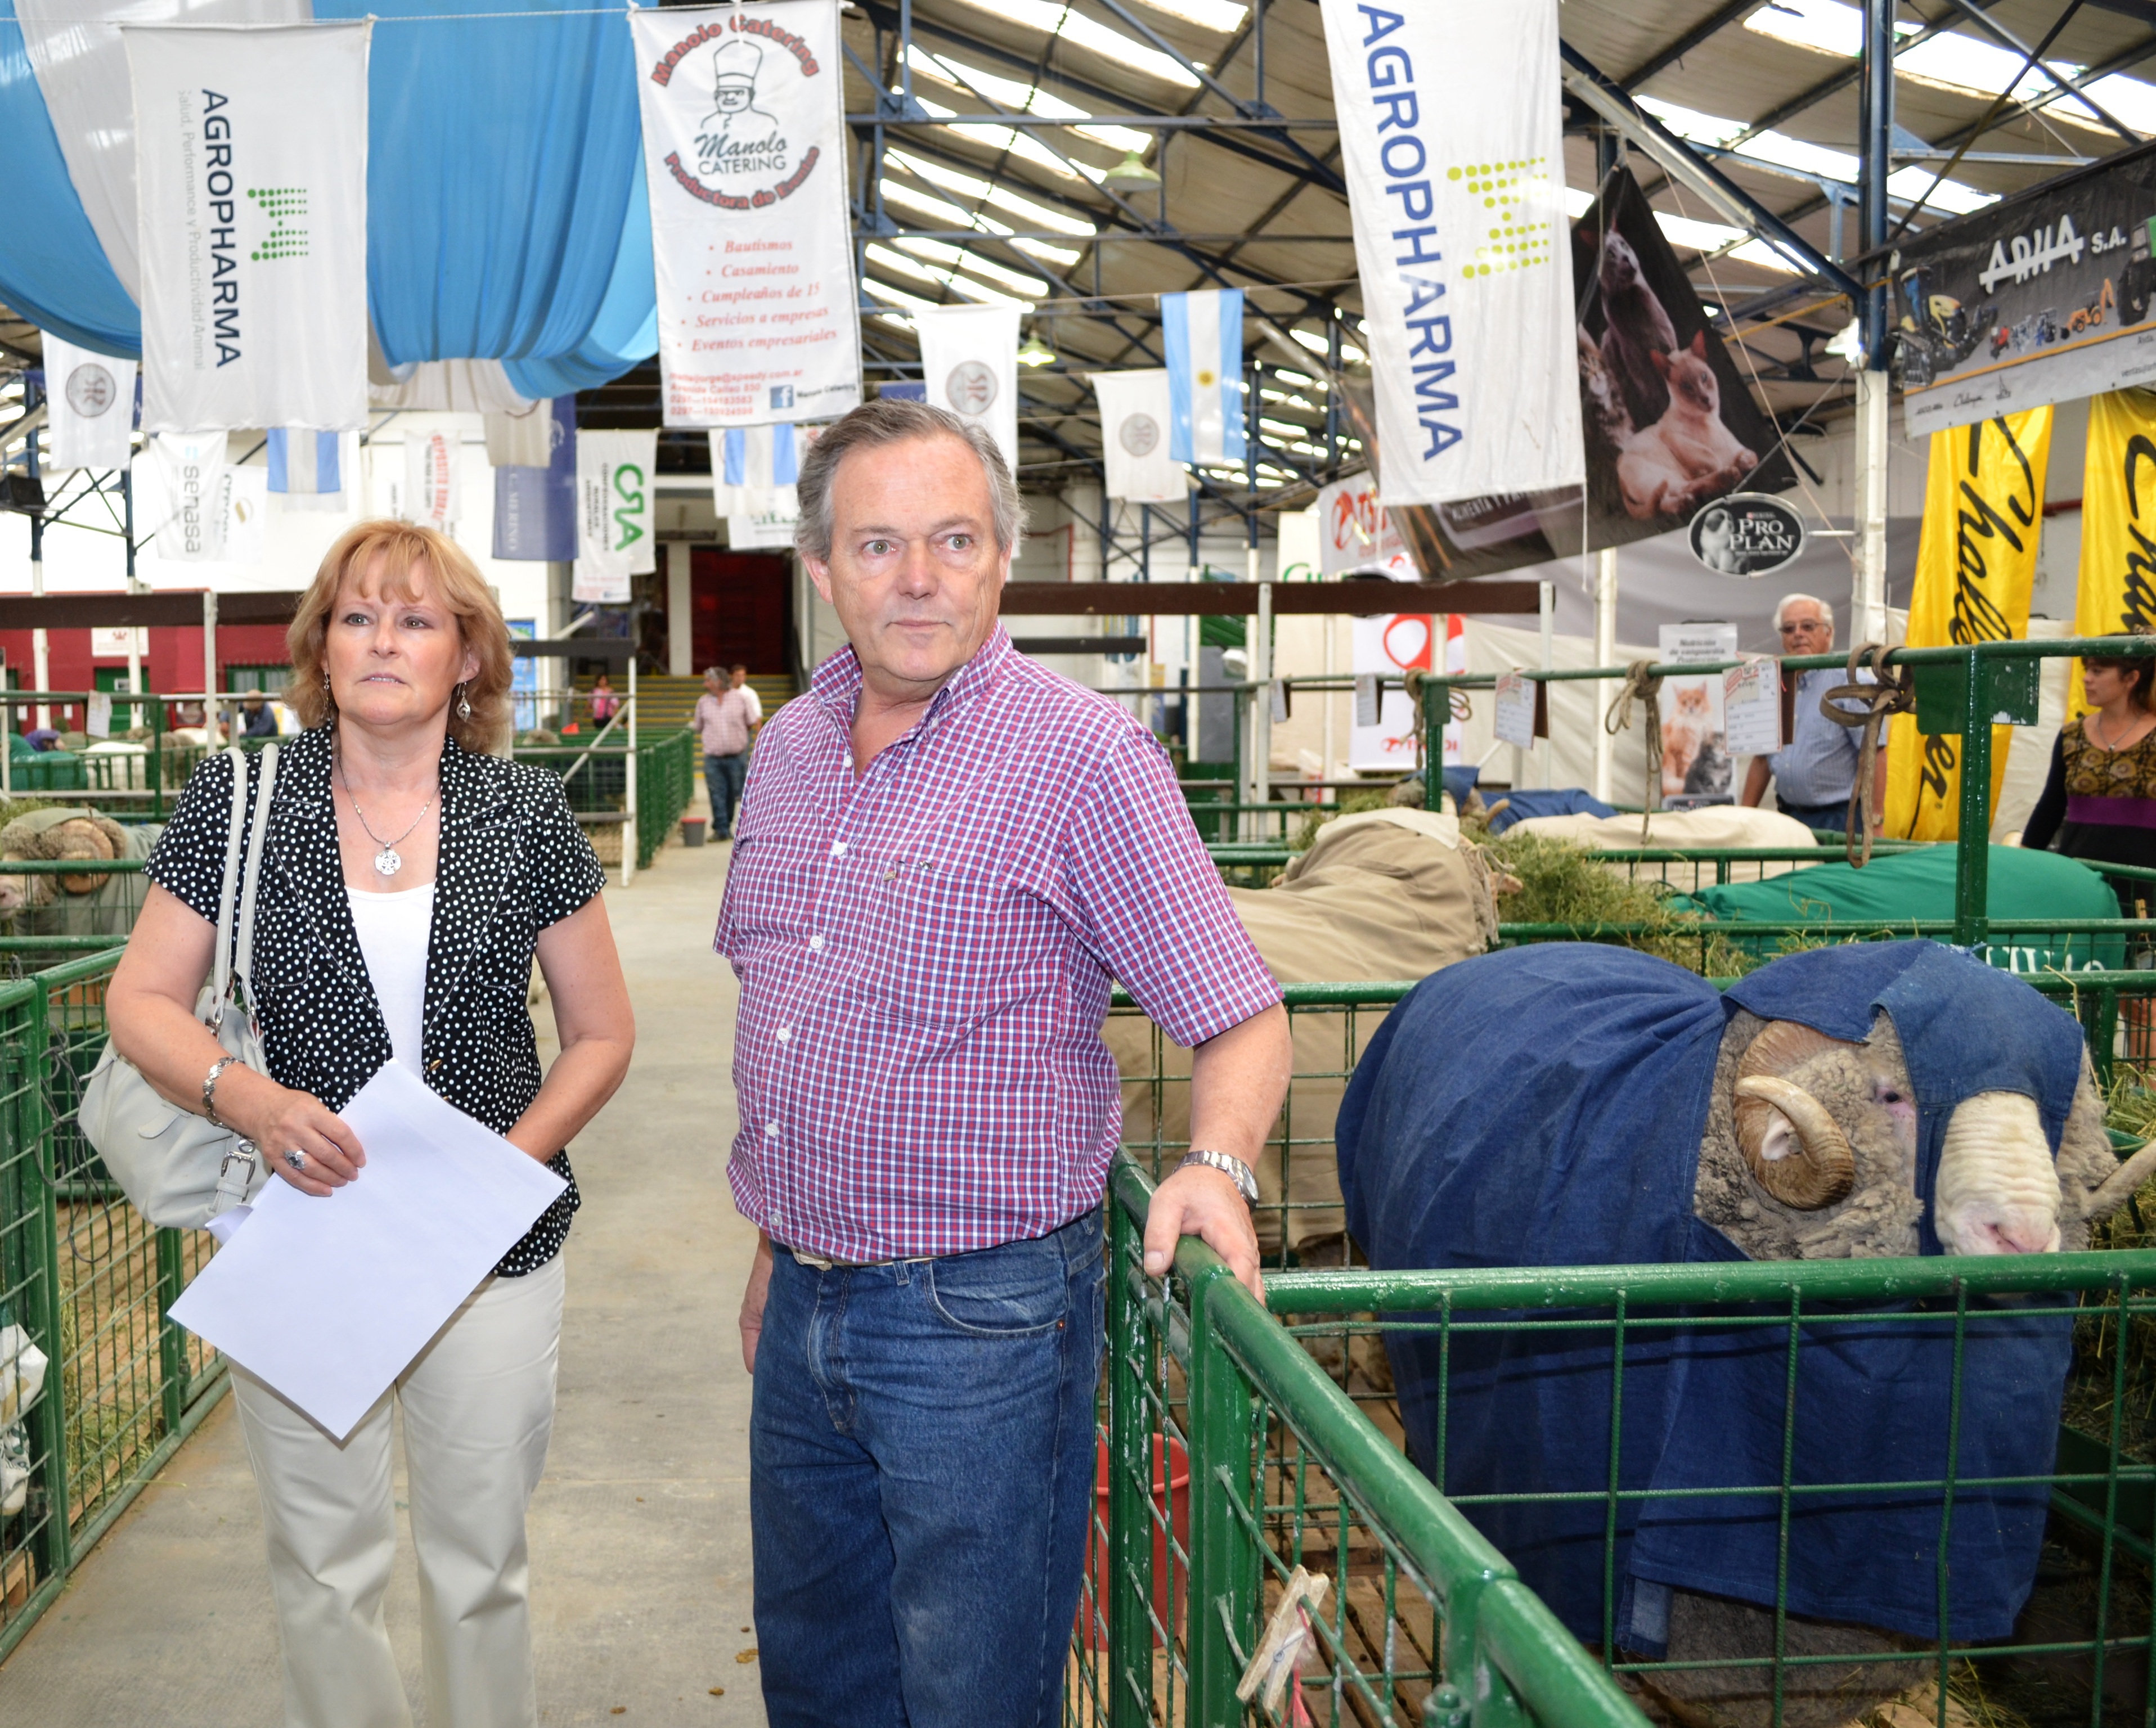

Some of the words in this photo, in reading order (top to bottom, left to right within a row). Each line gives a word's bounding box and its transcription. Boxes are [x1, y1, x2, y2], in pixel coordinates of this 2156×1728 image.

[651, 22, 722, 87] Manolo
[729, 14, 820, 77] Catering
[694, 130, 787, 158] Manolo
[182, 132, 197, 216] Performance
[664, 150, 750, 210] Productora
[752, 190, 776, 208] de
[774, 146, 820, 200] Eventos
[698, 155, 787, 176] CATERING
[202, 88, 241, 367] AGROPHARMA
[1358, 4, 1463, 461] AGROPHARMA
[2091, 226, 2126, 254] S.A.
[724, 239, 793, 254] Bautismos
[189, 232, 204, 321] Productividad
[721, 263, 799, 278] Casamiento
[701, 285, 783, 305] Cumpleaños
[787, 283, 802, 298] de
[695, 313, 756, 328] Servicios
[759, 314, 767, 323] a
[771, 307, 829, 325] empresas
[691, 338, 744, 352] Eventos
[748, 328, 838, 350] empresariales
[184, 465, 201, 554] senasa
[1738, 518, 1784, 536] PRO
[1729, 534, 1795, 550] PLAN
